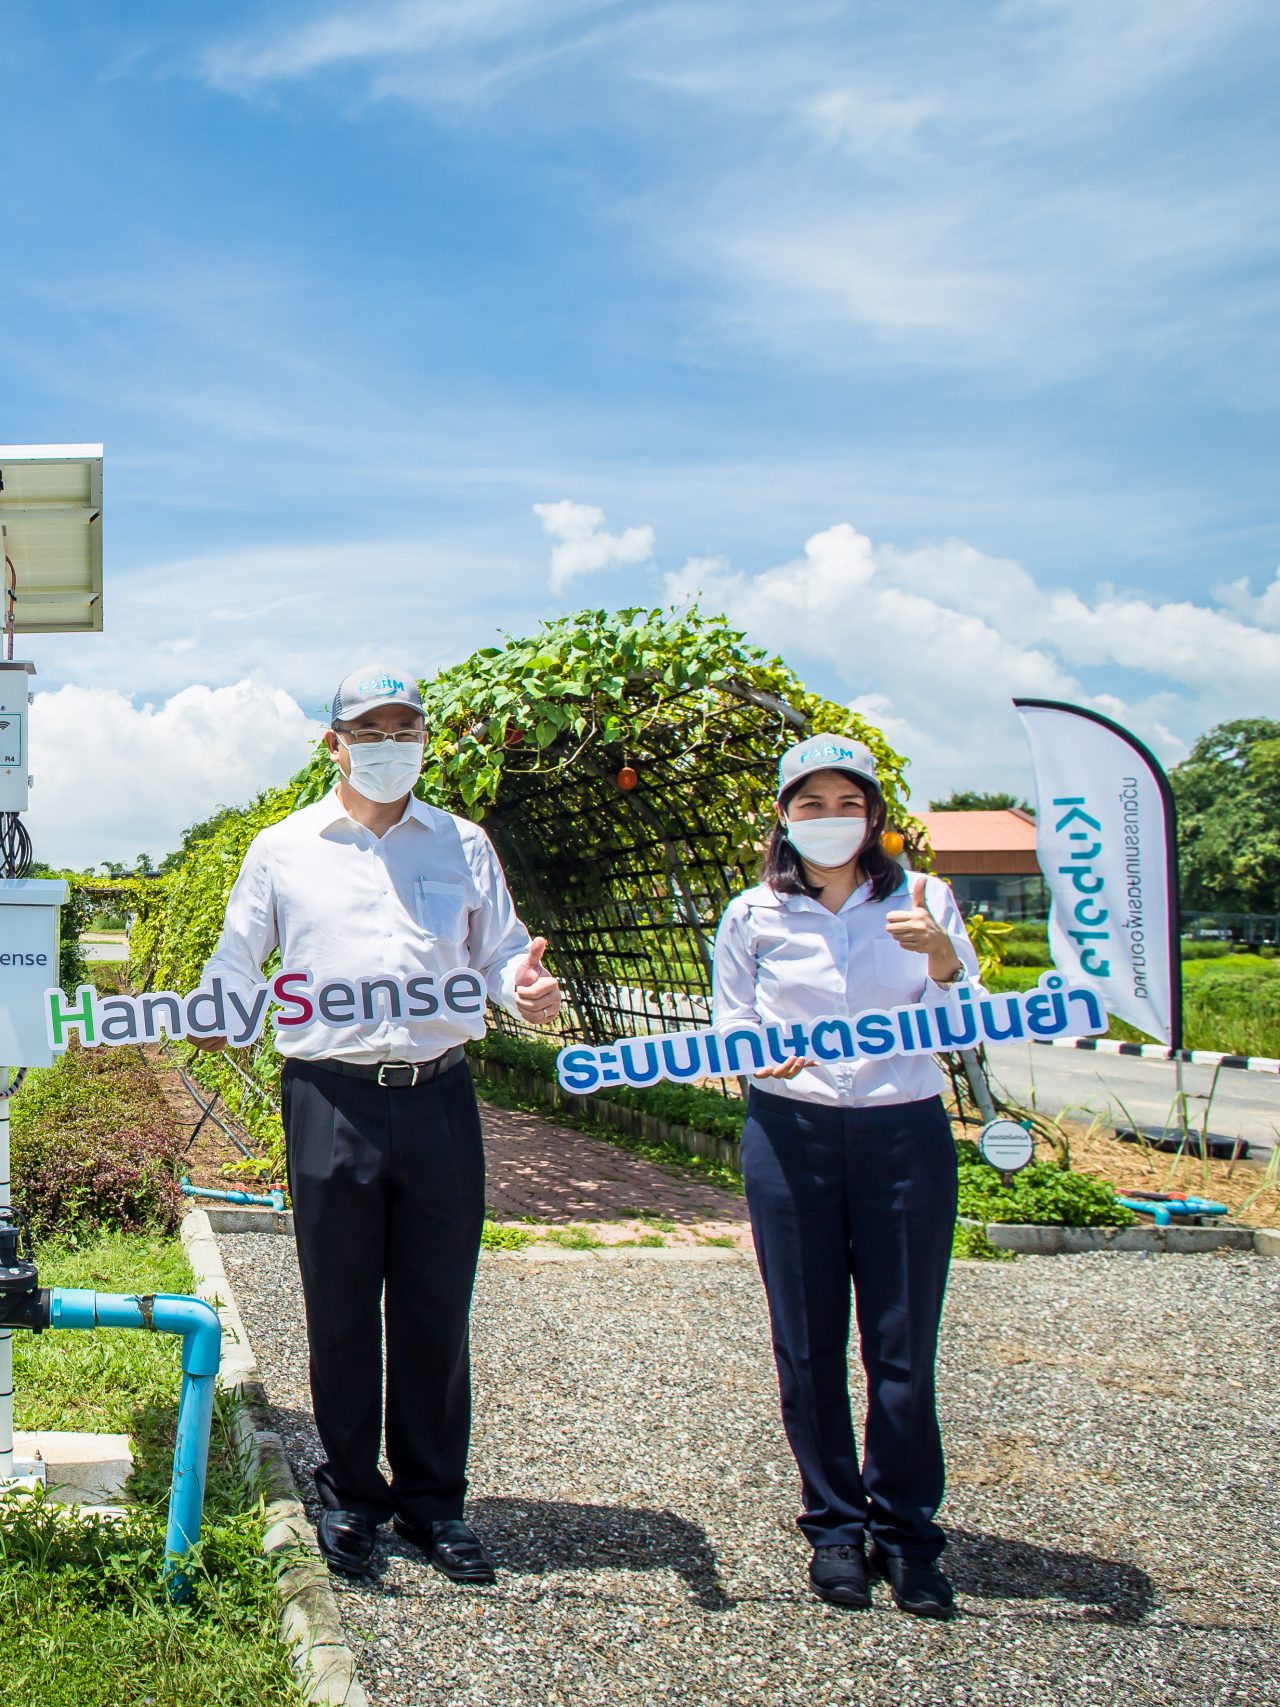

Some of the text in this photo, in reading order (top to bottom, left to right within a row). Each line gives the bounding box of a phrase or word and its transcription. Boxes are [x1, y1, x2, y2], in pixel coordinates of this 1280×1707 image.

[4, 755, 15, 763] R4
[48, 972, 483, 1045] HandySense
[561, 975, 1103, 1090] ระบบเกษตรแม่นยำ
